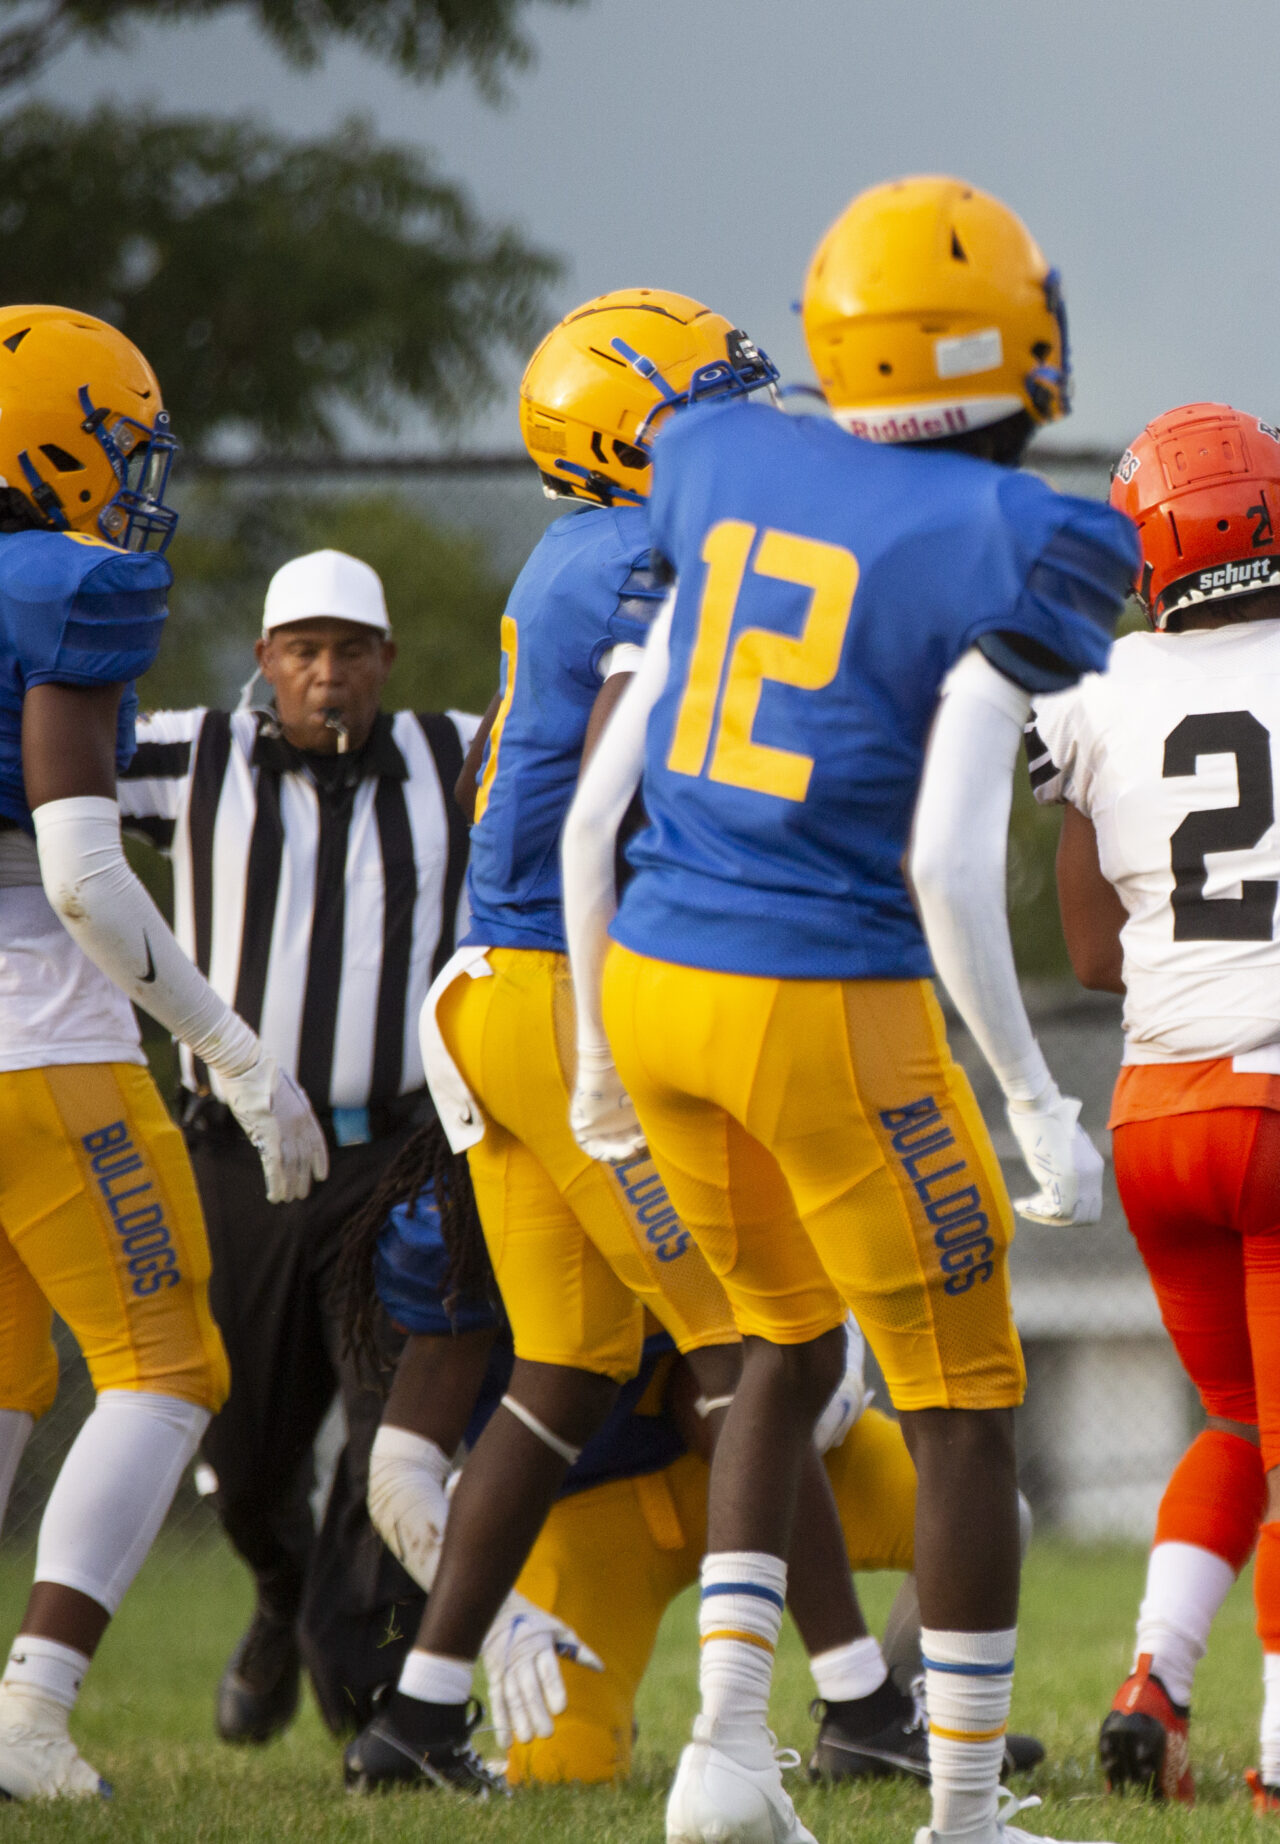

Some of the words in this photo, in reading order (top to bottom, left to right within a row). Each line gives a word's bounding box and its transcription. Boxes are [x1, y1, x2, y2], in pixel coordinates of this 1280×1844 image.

[850, 406, 968, 441] Riddell
[1200, 558, 1271, 590] schutt
[1246, 504, 1274, 549] 2
[666, 517, 861, 803] 12
[1162, 710, 1279, 942] 2
[82, 1121, 181, 1297] BULLDOGS
[608, 1157, 691, 1263] LDOGS
[880, 1096, 995, 1297] BULLDOGS
